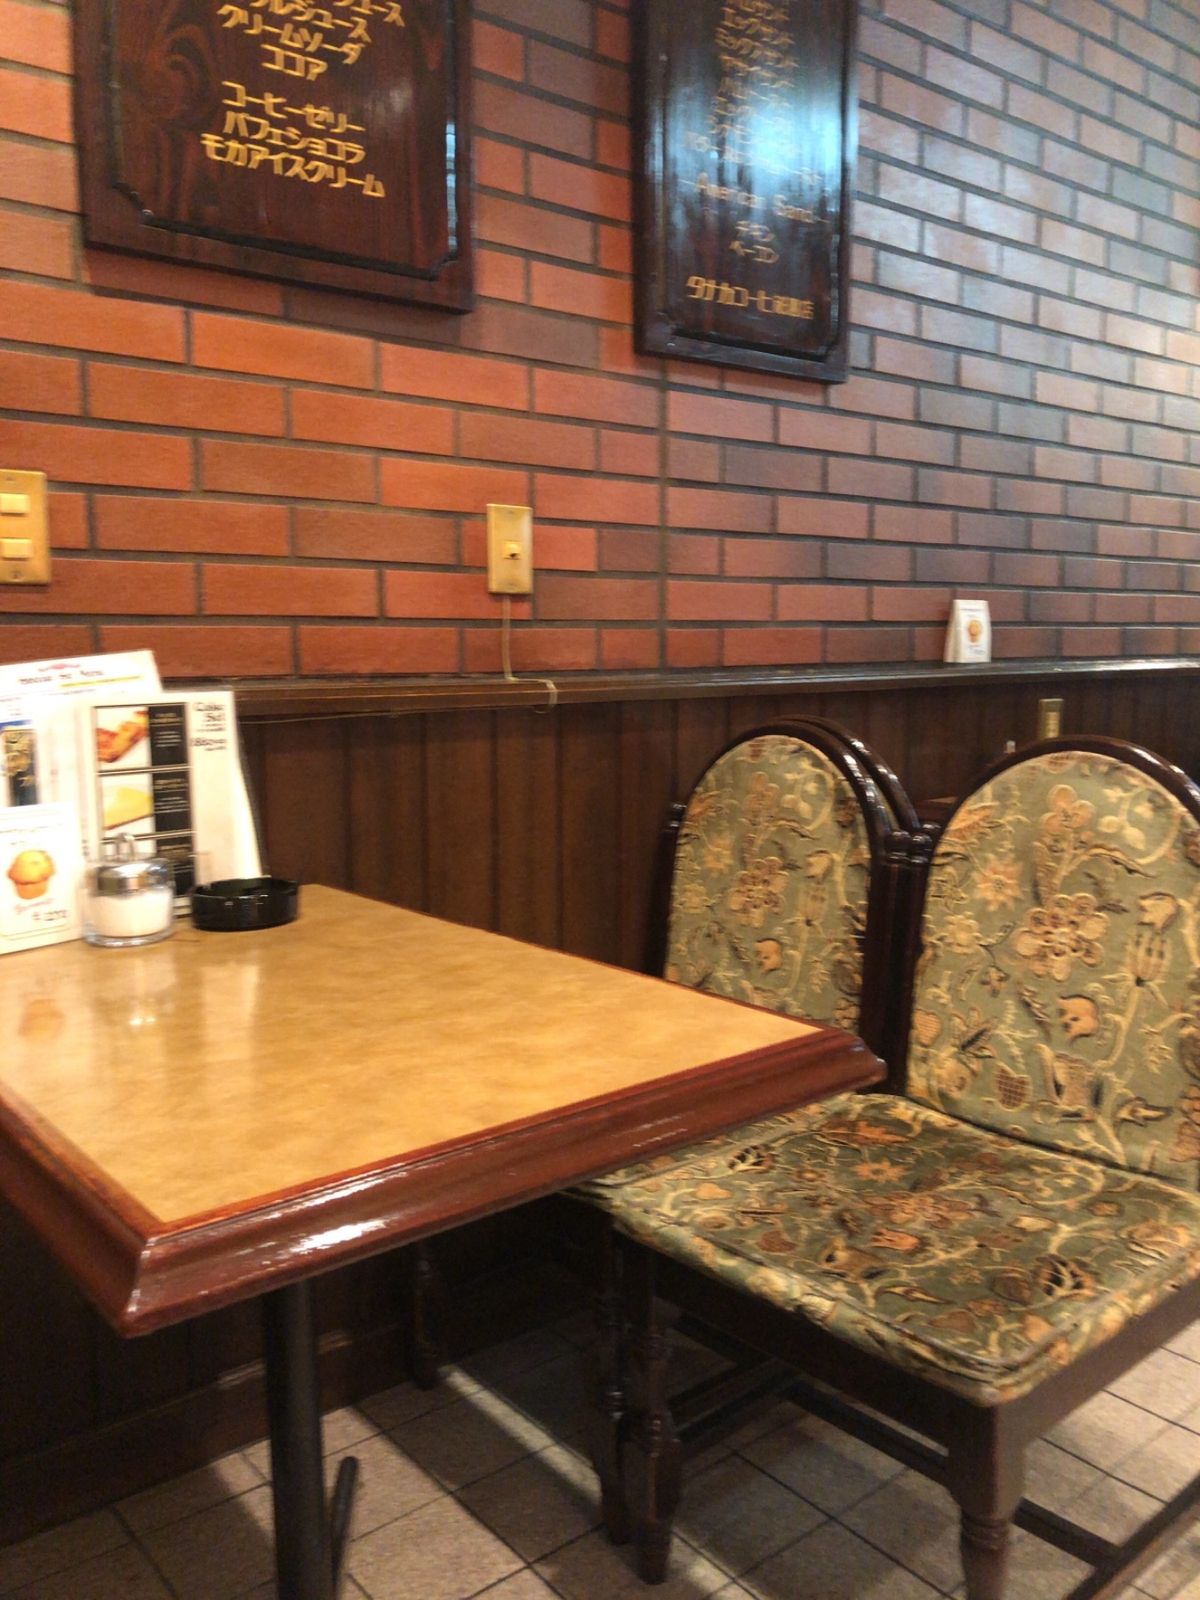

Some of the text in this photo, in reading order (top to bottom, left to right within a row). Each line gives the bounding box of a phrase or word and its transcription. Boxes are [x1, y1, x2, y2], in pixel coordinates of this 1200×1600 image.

[216, 4, 366, 65] クリームソーダ
[260, 43, 328, 81] ココア
[221, 80, 366, 134] コーヒーゼリー
[223, 110, 367, 165] パフェショコラ
[200, 133, 386, 198] モカアイスクリーム
